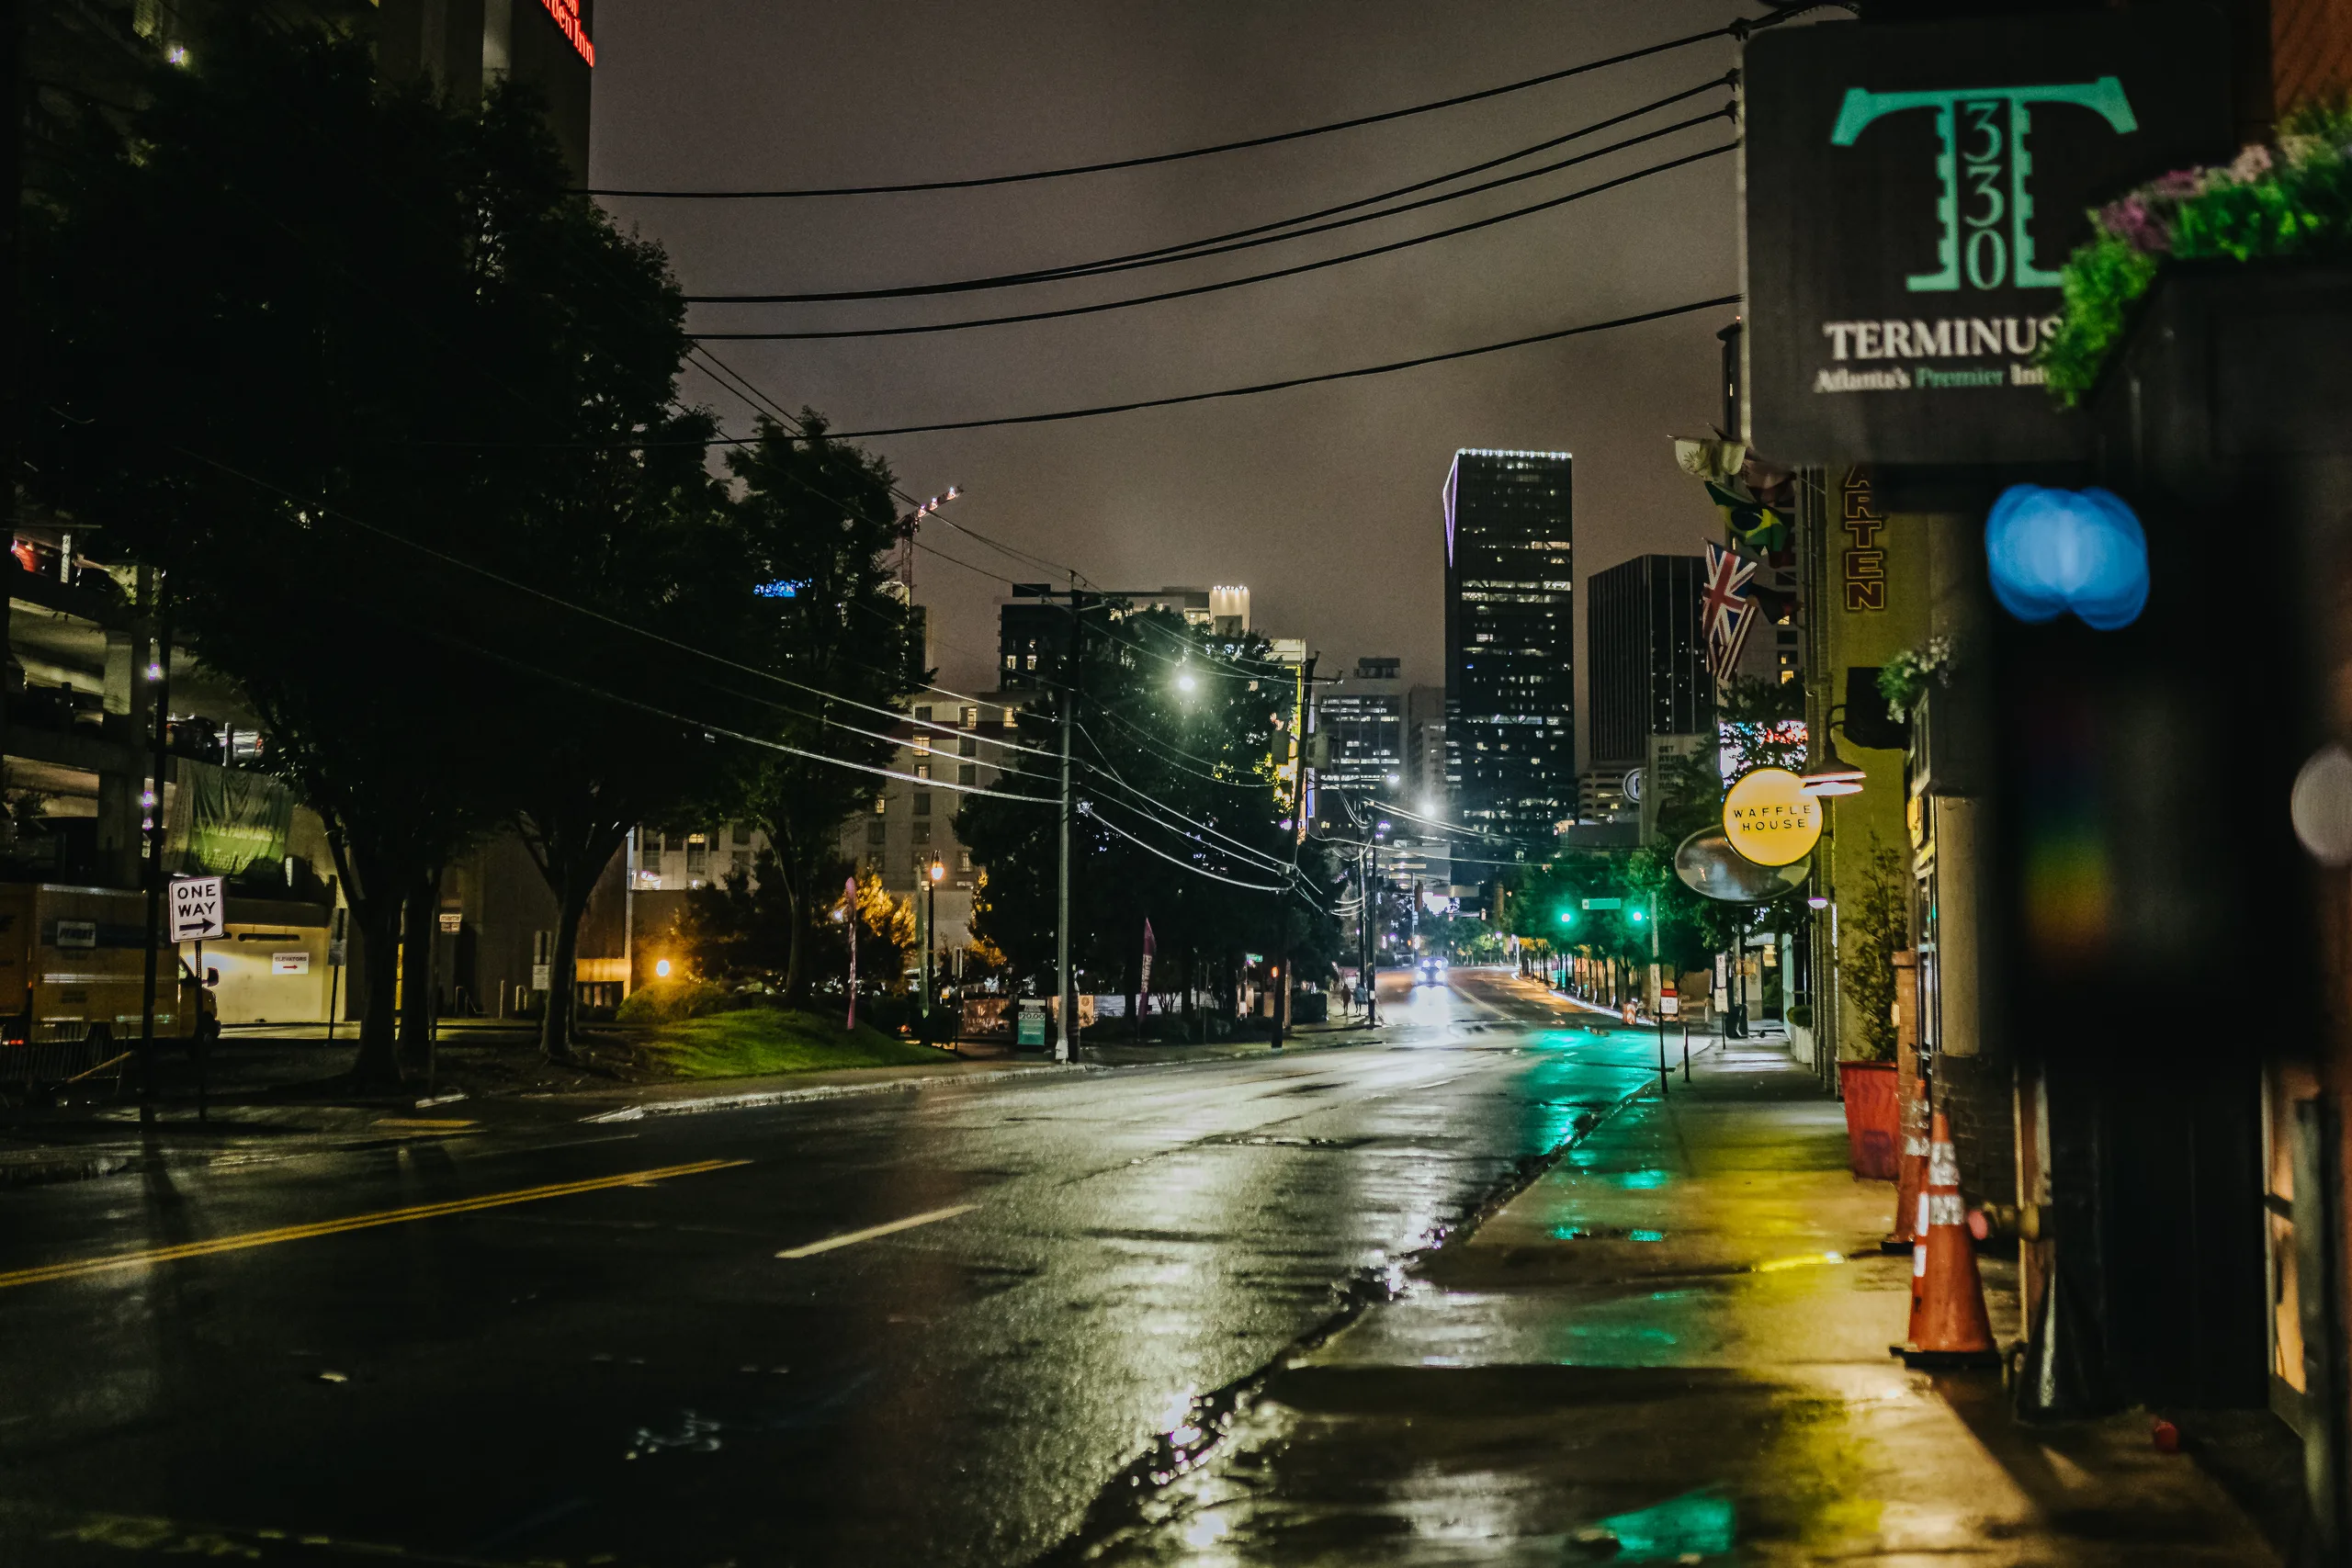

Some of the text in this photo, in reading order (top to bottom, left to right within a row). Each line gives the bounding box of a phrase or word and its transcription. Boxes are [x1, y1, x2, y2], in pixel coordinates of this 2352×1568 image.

[573, 18, 595, 68] Inn
[1962, 100, 2007, 290] 330
[1823, 315, 2064, 361] TERMINUS
[1734, 805, 1811, 818] WAFFLE
[1742, 818, 1805, 831] HOUSE
[177, 884, 216, 899] ONE
[177, 901, 216, 918] WAY
